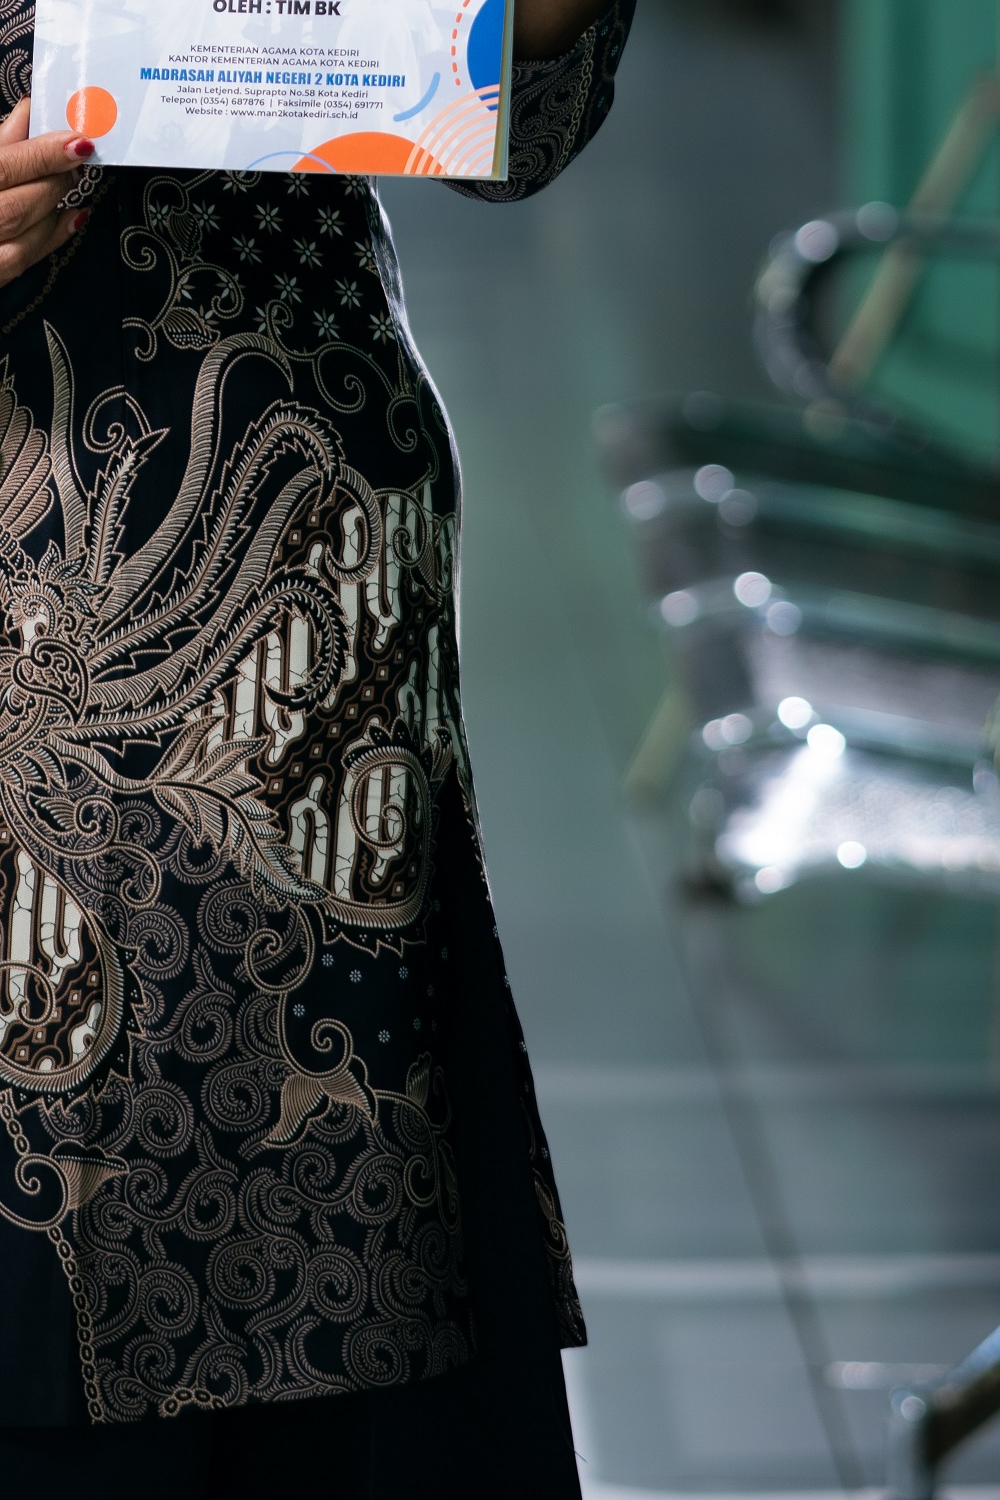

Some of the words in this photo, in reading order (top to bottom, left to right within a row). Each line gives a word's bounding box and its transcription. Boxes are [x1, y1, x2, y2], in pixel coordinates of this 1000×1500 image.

[275, 0, 310, 15] TIM
[314, 1, 341, 16] BK
[190, 45, 259, 54] KEMENTERIAN
[261, 46, 297, 55] AGAMA
[299, 47, 325, 56] KOTA
[327, 48, 360, 57] KEDIRI
[168, 55, 208, 63] KANTOR
[211, 56, 279, 65] KEMENTERIAN
[282, 58, 317, 67] AGAMA
[320, 59, 345, 68] KOTA
[348, 60, 380, 68] KEDIRI
[140, 67, 215, 82] MADRASAH
[217, 70, 263, 84] ALIYAH
[266, 71, 311, 85] NEGERI
[314, 72, 323, 86] 2
[326, 73, 359, 87] KOTA
[362, 74, 406, 87] KEDIRI
[176, 85, 202, 94] Jalan
[204, 86, 242, 96] Letjend.
[244, 87, 287, 97] Suprapto
[289, 89, 315, 97] No.58
[318, 89, 339, 98] Kota
[341, 90, 368, 99] Kediri
[160, 95, 198, 105] Telepon
[200, 97, 229, 107] (0354)
[231, 98, 265, 106] 687876
[277, 99, 321, 108] Faksimile
[323, 100, 352, 110] (0354)
[354, 101, 383, 110] 691771
[185, 107, 223, 116] Website
[230, 109, 358, 119] www.man2kotakediri.sch.id
